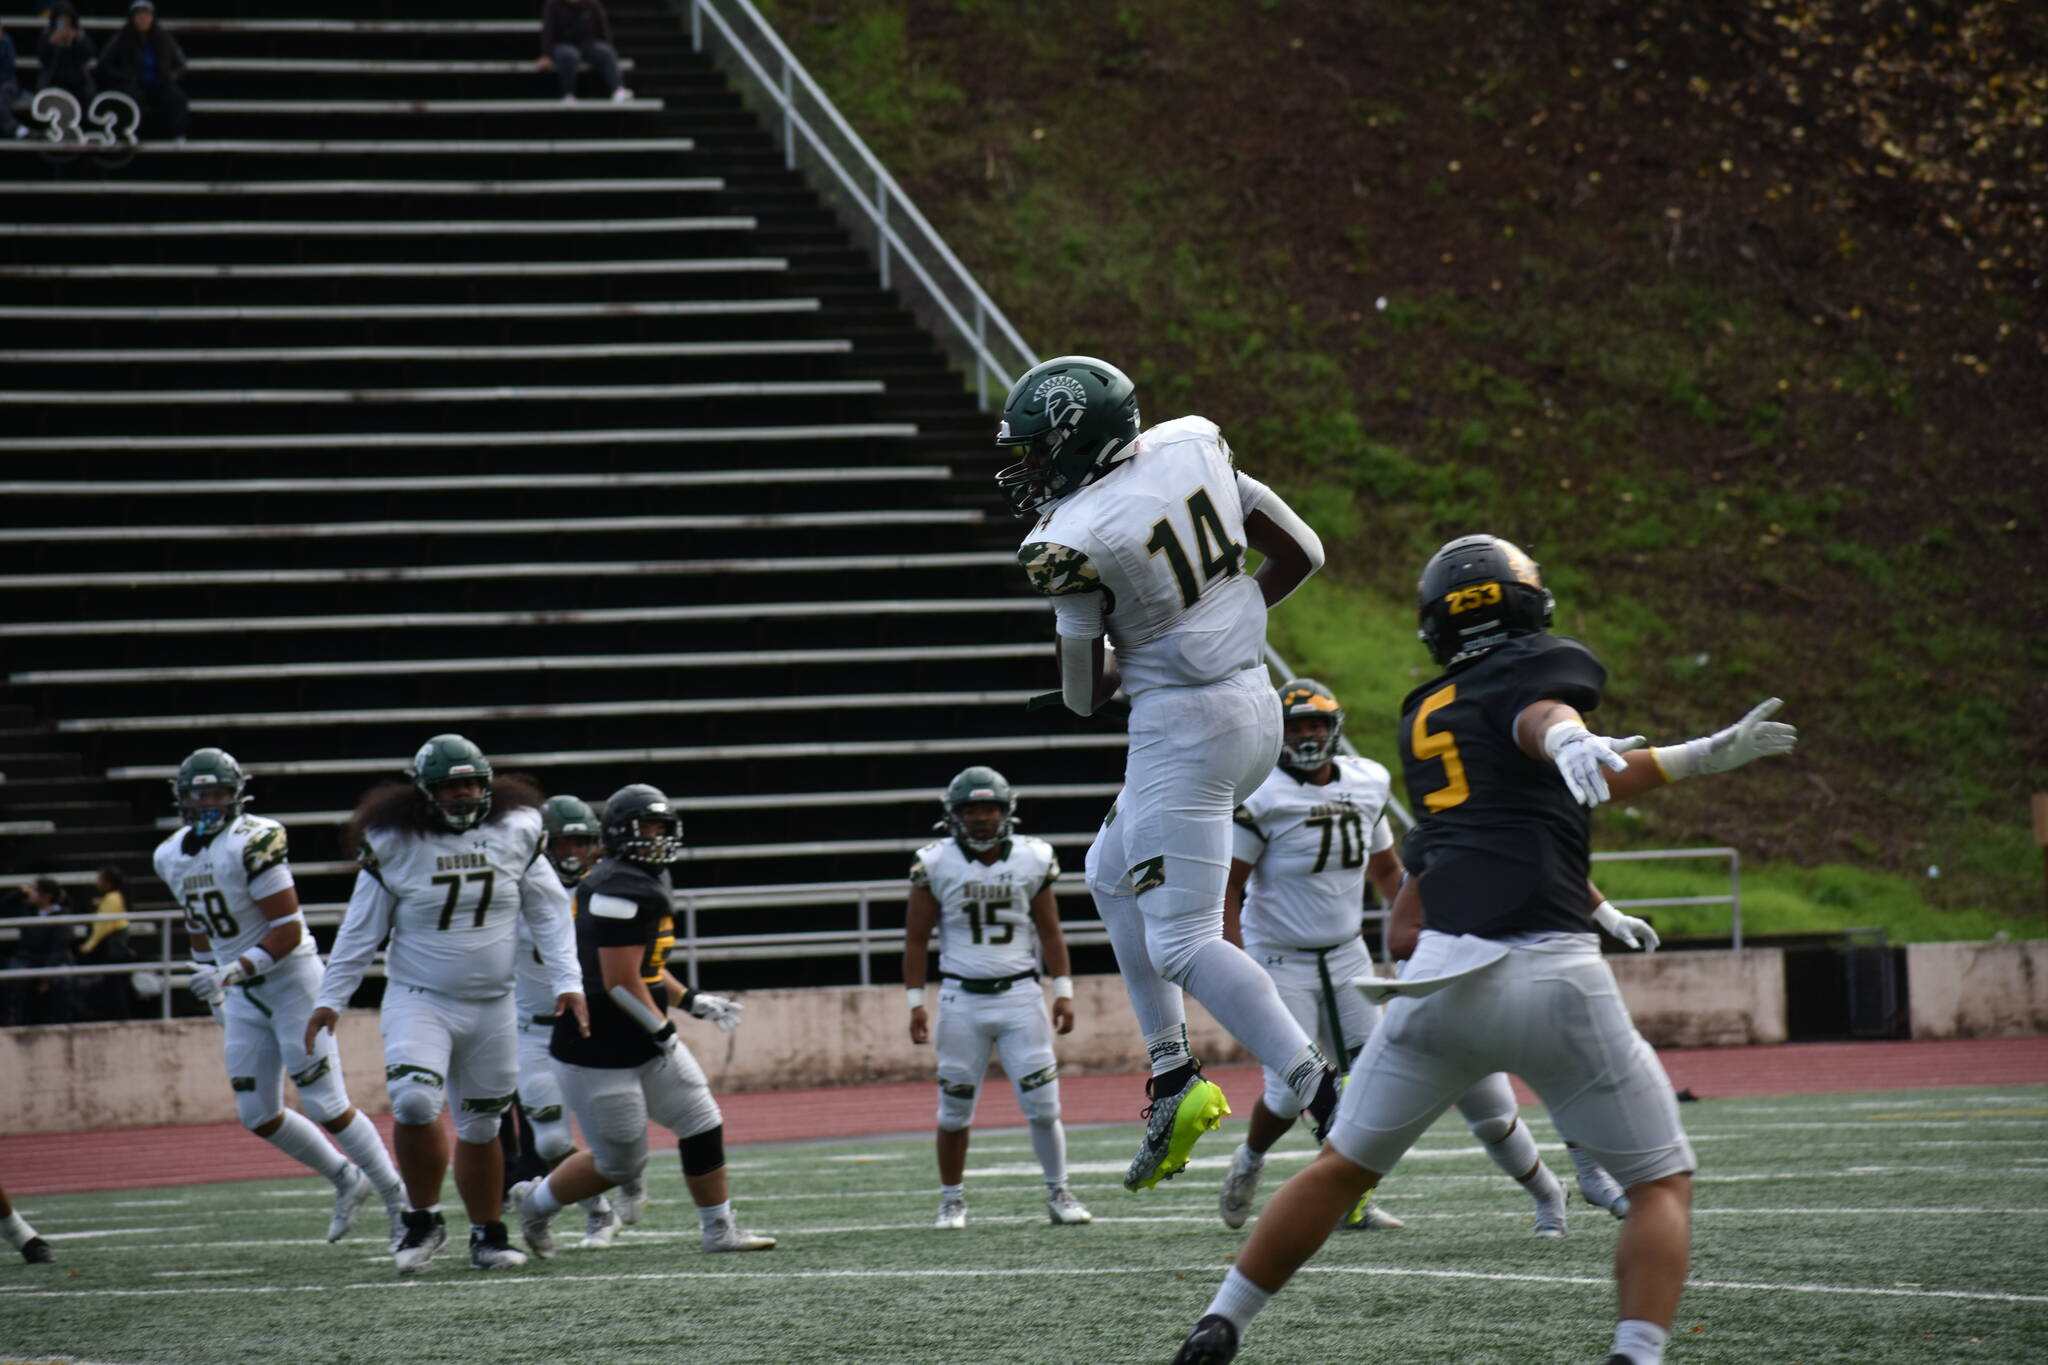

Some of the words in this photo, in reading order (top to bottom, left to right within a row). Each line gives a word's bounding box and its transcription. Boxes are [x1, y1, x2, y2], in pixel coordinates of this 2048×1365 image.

[1143, 485, 1243, 610] 14
[1444, 582, 1502, 615] 253
[1411, 683, 1470, 814] 5
[1304, 810, 1364, 874] 70
[184, 889, 240, 939] 58
[431, 868, 495, 931] 77
[961, 900, 1014, 945] 15
